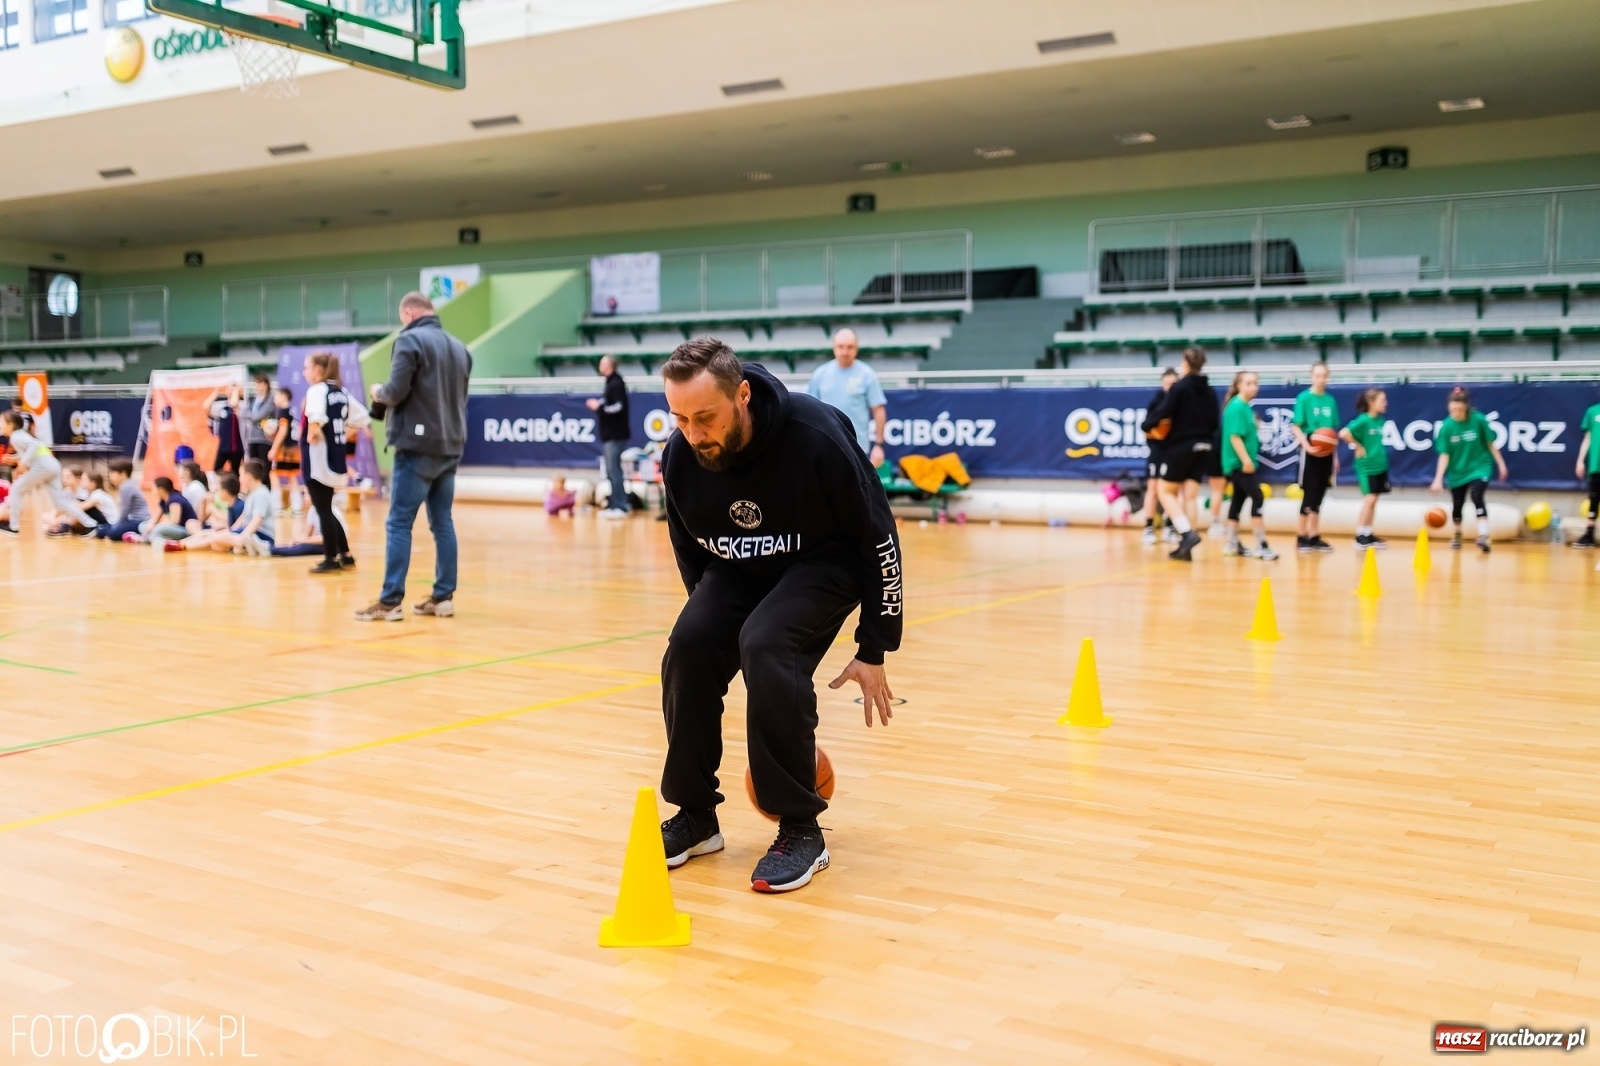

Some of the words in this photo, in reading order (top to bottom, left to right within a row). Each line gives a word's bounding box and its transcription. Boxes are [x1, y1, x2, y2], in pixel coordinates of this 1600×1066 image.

[485, 411, 596, 443] RACIBÓRZ
[868, 411, 997, 447] CIBÓRZ
[1348, 410, 1567, 453] ACÓRZ
[875, 533, 902, 616] TRENER
